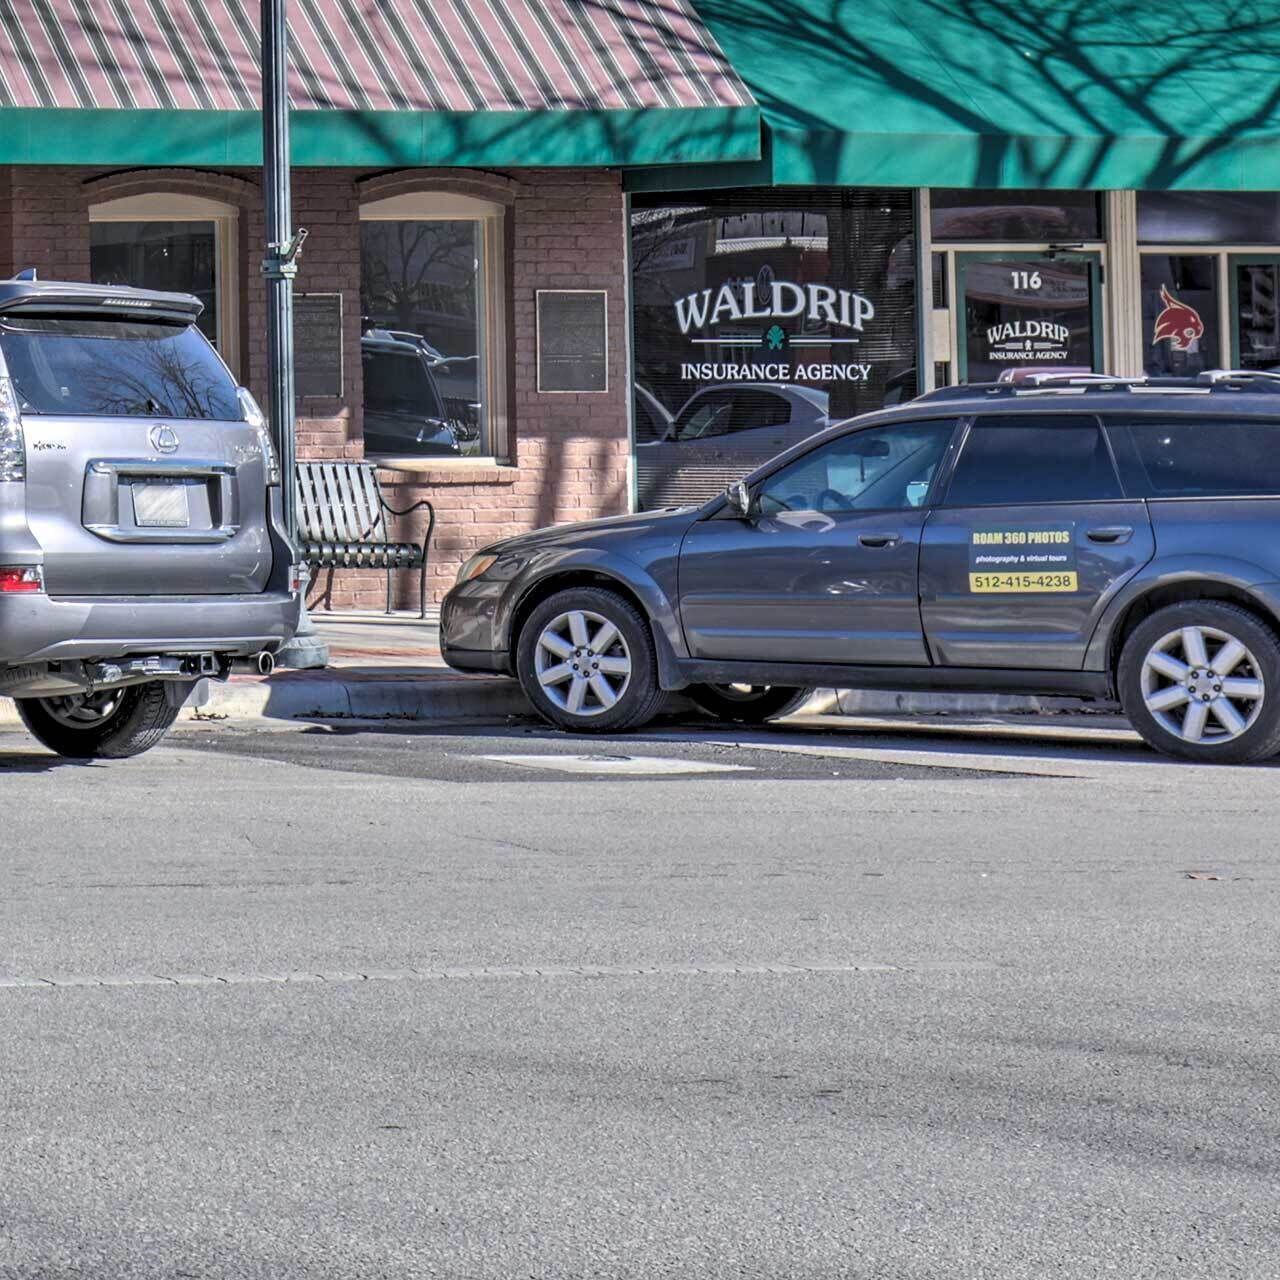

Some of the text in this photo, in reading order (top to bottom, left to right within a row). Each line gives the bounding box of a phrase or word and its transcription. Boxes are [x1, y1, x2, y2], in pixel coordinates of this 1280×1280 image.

[1010, 271, 1043, 290] 116
[674, 281, 875, 335] WALDRIP
[986, 320, 1070, 344] WALDRIP
[989, 351, 1068, 361] INSURANCE AGENCY
[680, 362, 872, 380] INSURANCE AGENCY
[972, 531, 1070, 545] ROAM 360 PHOTOS
[975, 555, 1020, 564] photography
[974, 575, 1072, 588] 512-415-4238
